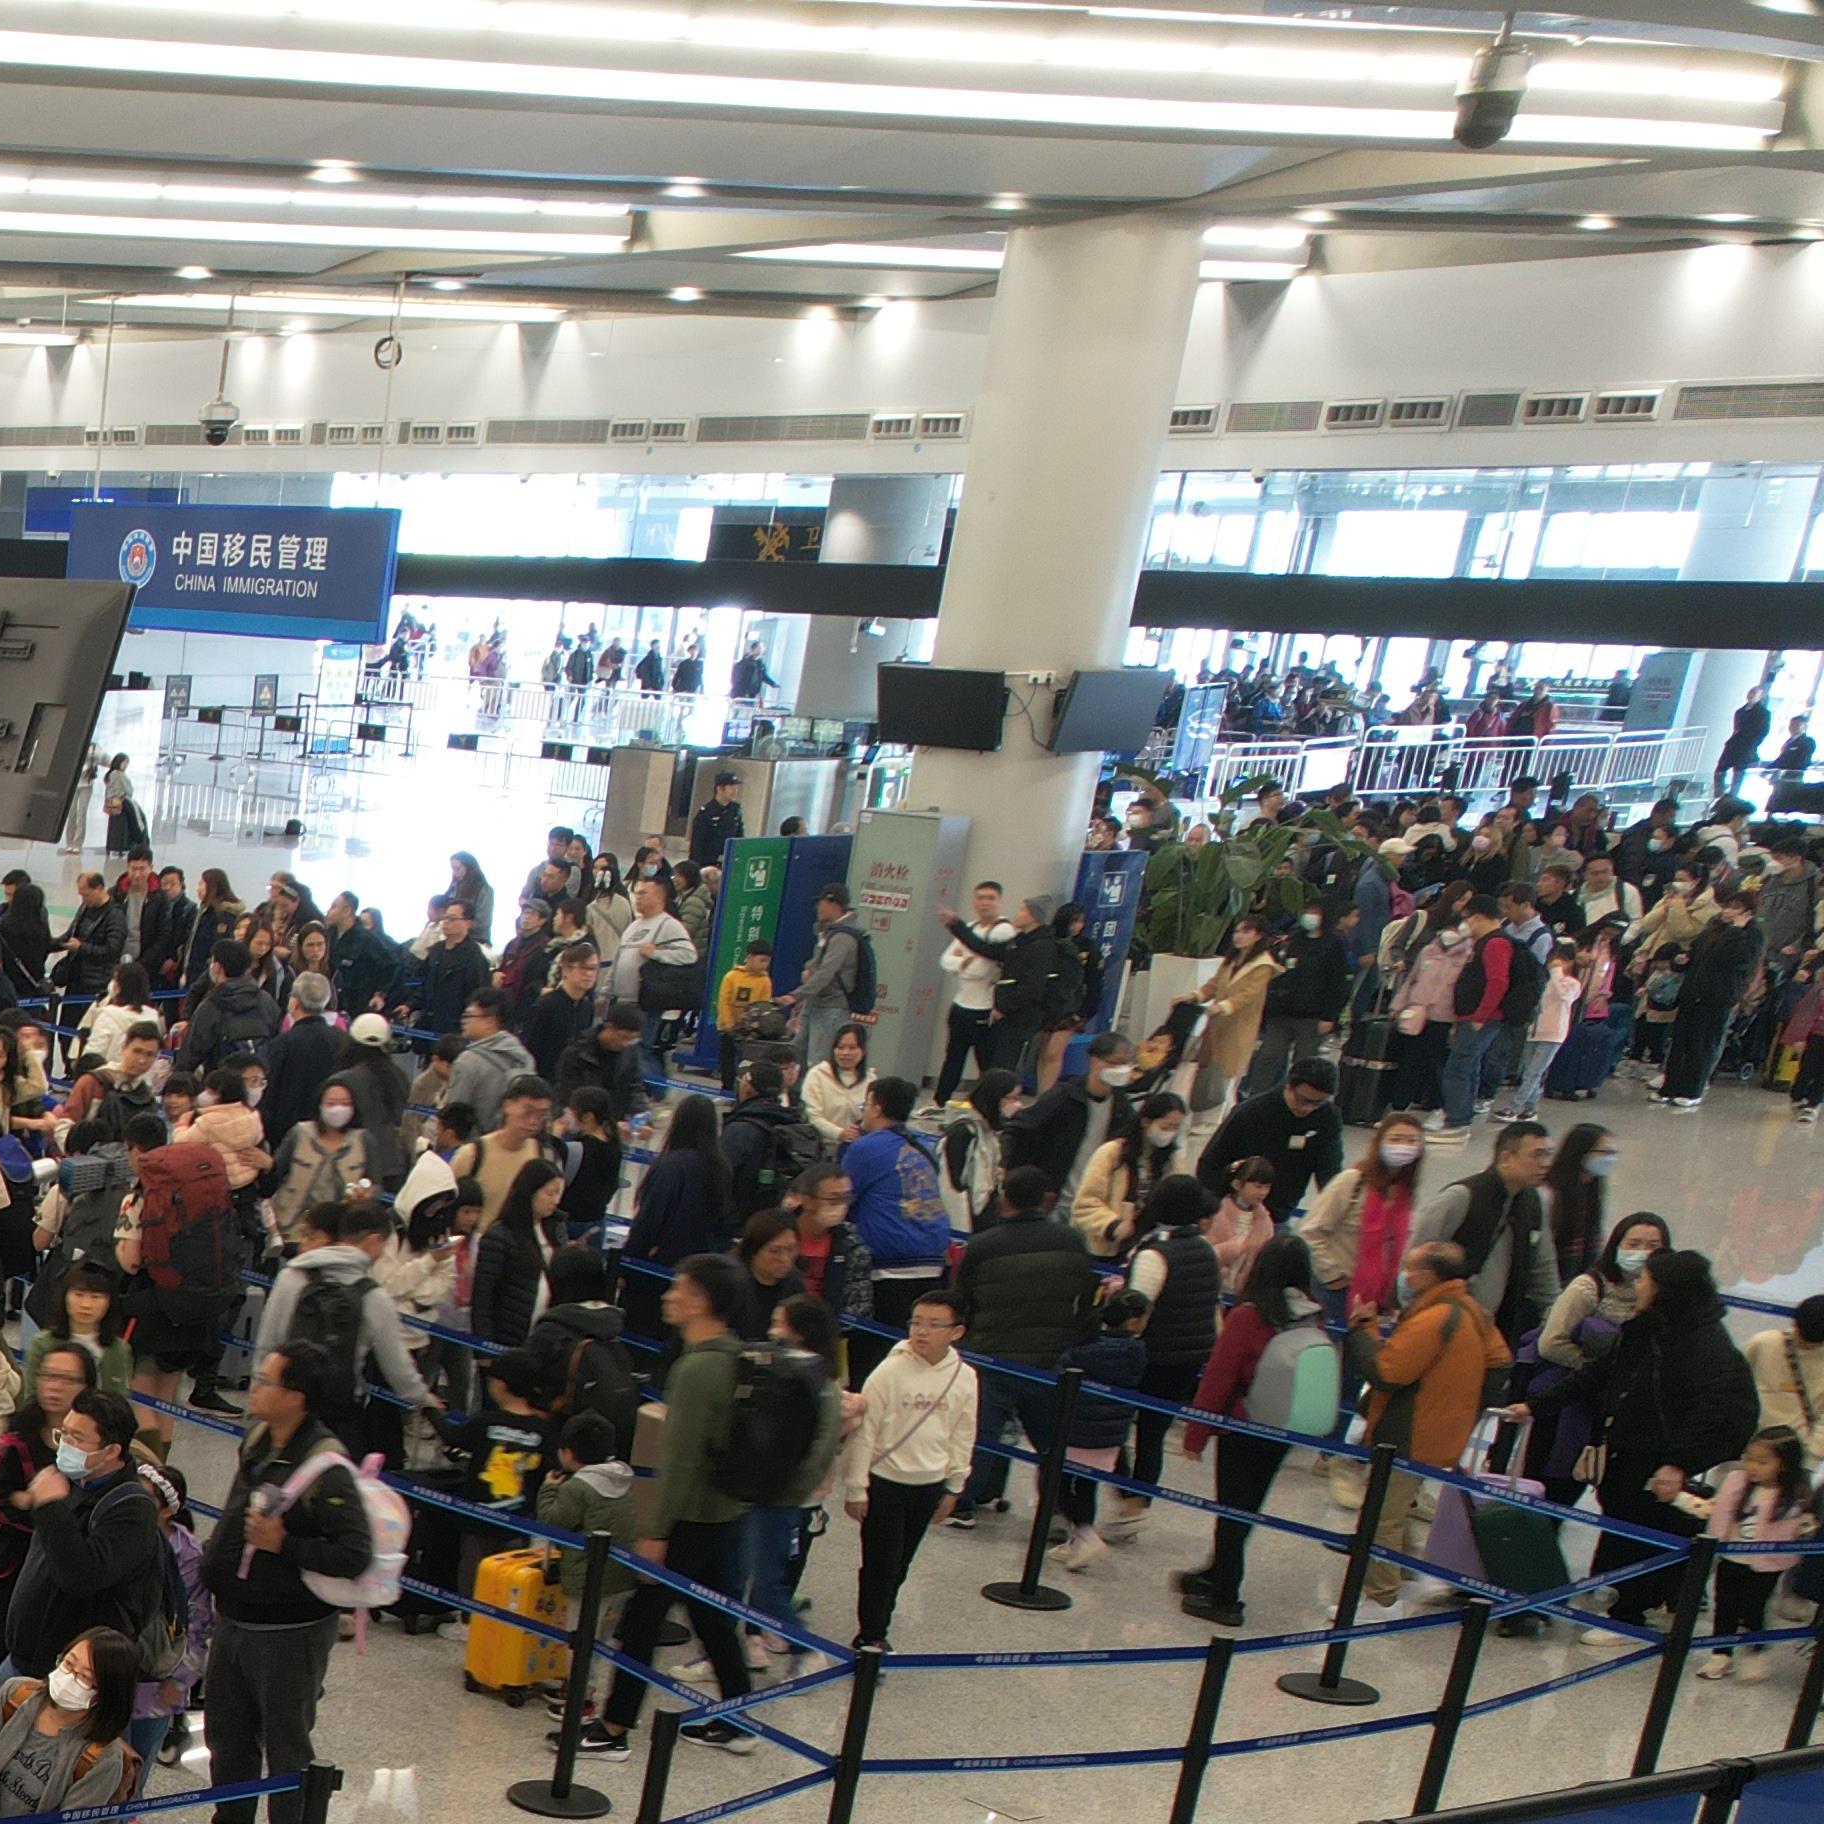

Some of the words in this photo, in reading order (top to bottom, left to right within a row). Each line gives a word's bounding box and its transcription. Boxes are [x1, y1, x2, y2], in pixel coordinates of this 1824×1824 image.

[171, 530, 329, 572] 中国移民管理
[174, 574, 216, 592] CHINA
[223, 576, 319, 598] IMMIGRATION
[870, 862, 910, 880] 消火栓
[62, 1804, 121, 1822] 中国移民管理
